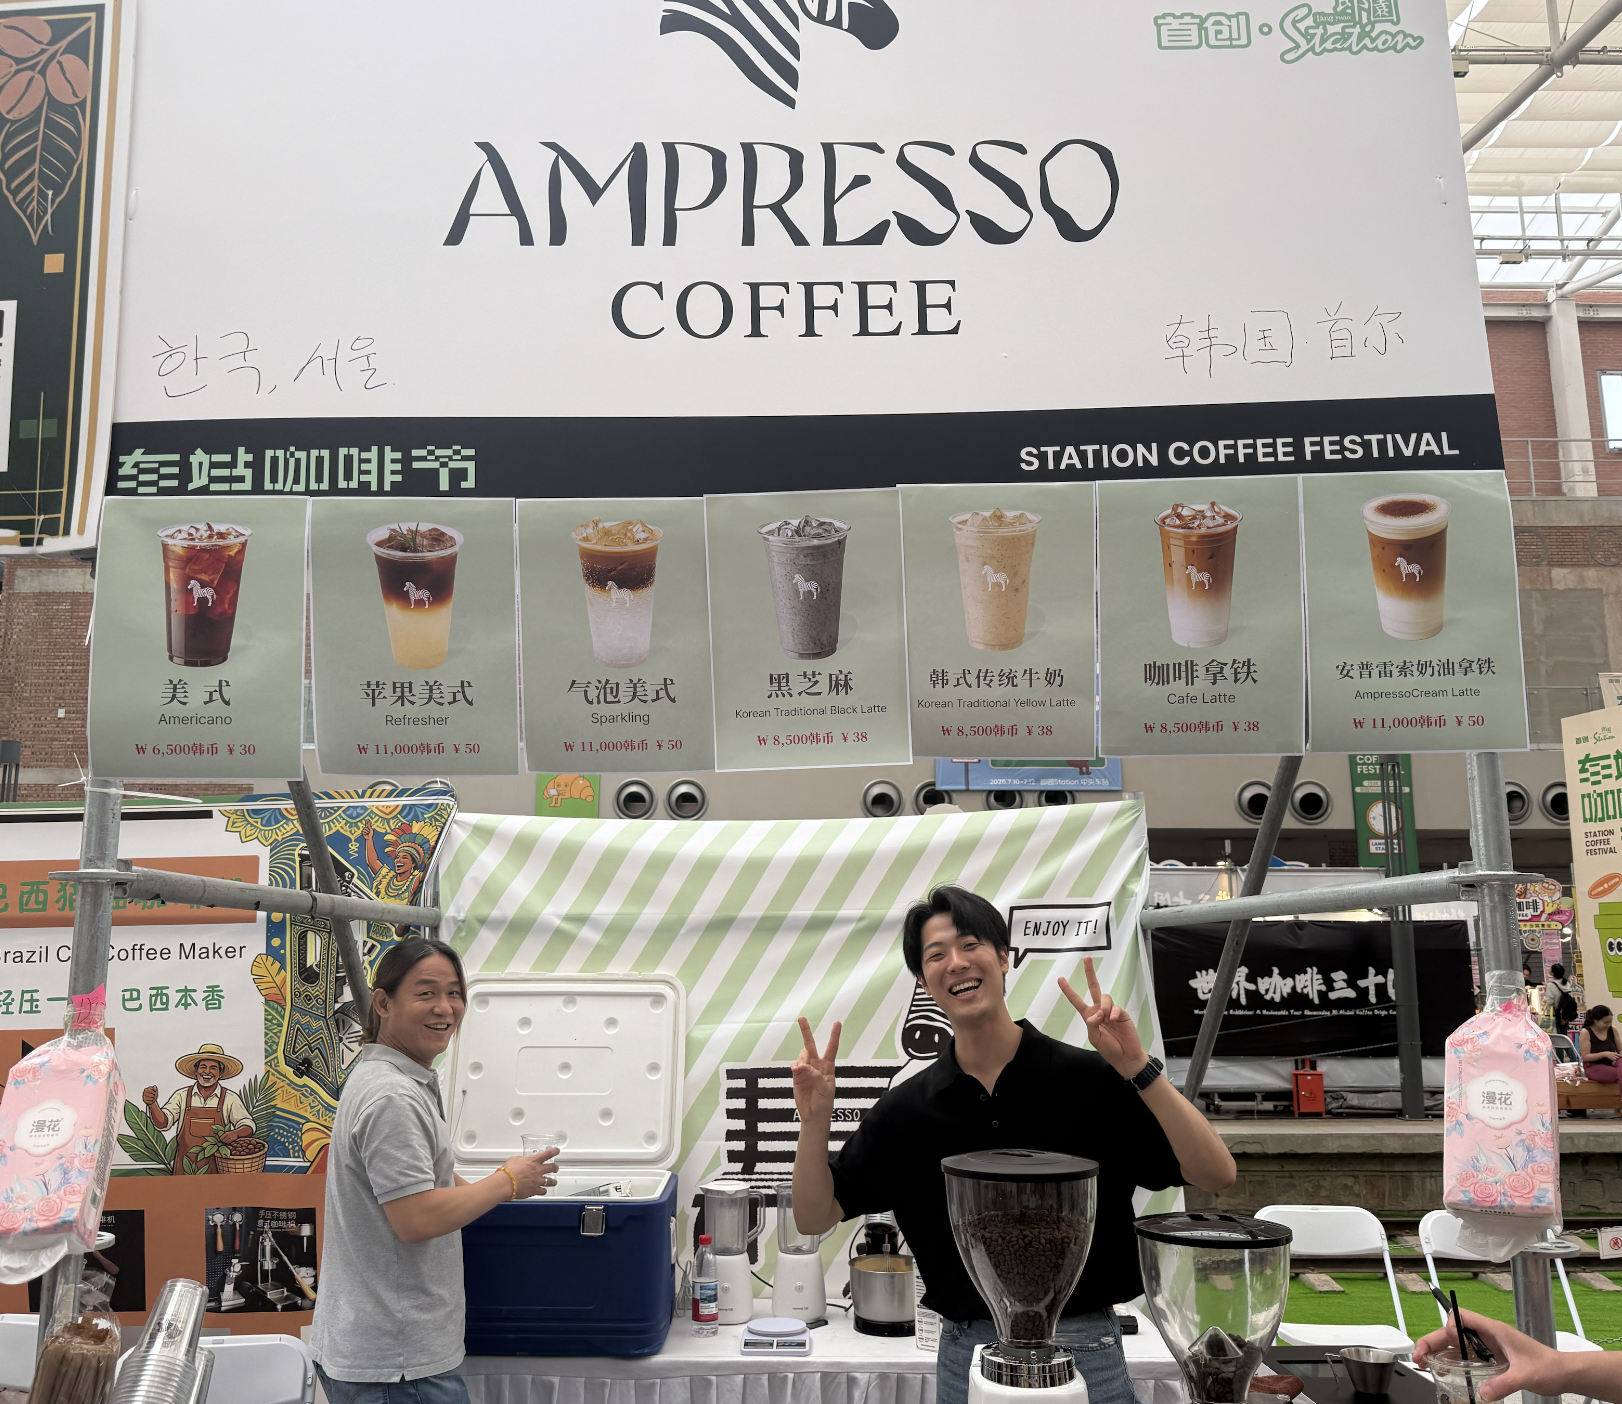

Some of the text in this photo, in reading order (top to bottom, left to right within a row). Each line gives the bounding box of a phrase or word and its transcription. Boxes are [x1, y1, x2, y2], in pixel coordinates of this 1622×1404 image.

[1154, 3, 1424, 64] 首创 Station
[441, 138, 1120, 248] AMPRESSO
[609, 278, 962, 341] COFFEE
[1019, 431, 1460, 472] STATION COFFEE FESTIVAL
[1142, 656, 1259, 688] 咖啡拿铁
[1335, 656, 1497, 681] 安普雷索奶油拿铁
[766, 669, 854, 700] 黑芝麻
[928, 666, 1065, 690] 韩式传统牛奶
[359, 678, 475, 708] 苹果美式
[566, 676, 677, 706] 气泡美式
[1166, 691, 1237, 705] Cafe Latte
[1354, 687, 1481, 702] AmpressoCream Latte
[735, 704, 888, 719] Korean Traditional Black Latte
[917, 697, 1077, 709] Korean Traditional Yellow Latte
[157, 712, 233, 726] Americano
[384, 713, 450, 727] Refresher
[590, 711, 650, 727] Sparkling
[1356, 755, 1379, 764] COF
[1584, 828, 1615, 840] STATION
[1585, 837, 1611, 848] COFFEE
[1586, 846, 1618, 857] FESTIVAL
[1023, 918, 1099, 937] ENJOY IT!
[0, 945, 49, 964] razil
[177, 941, 247, 961] Maker
[1188, 965, 1396, 1006] 世界咖啡三十
[120, 983, 226, 1013] 巴西本香
[1481, 1090, 1513, 1106] 漫花
[792, 1108, 861, 1121] AESSO
[29, 1119, 61, 1134] 漫花
